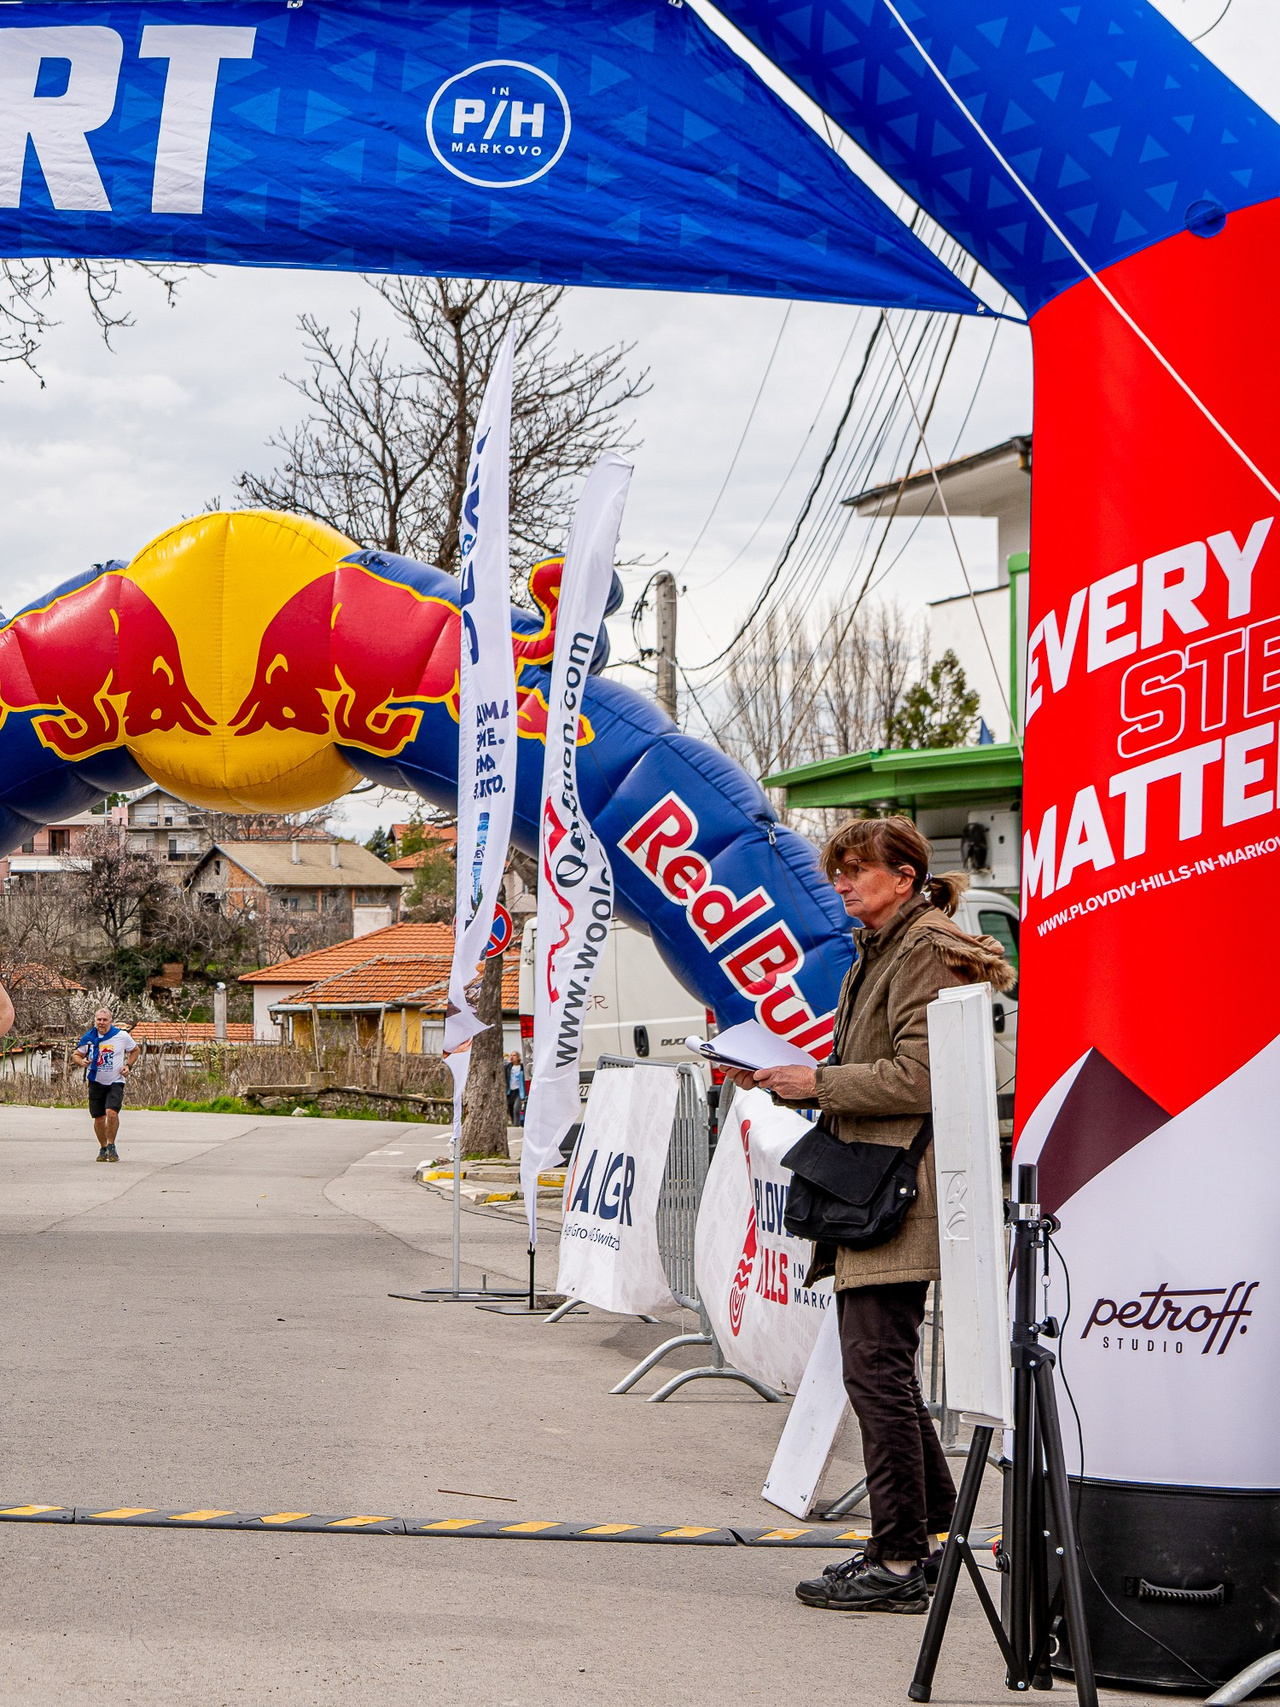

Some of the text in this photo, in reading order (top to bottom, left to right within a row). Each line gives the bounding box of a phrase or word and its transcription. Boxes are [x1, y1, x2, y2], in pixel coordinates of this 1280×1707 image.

[491, 86, 510, 96] IN
[452, 98, 545, 140] P/H
[451, 142, 542, 157] MARKOVO
[1025, 516, 1275, 727] EVERY
[1117, 616, 1280, 759] STE
[1021, 719, 1280, 922] MATTE
[622, 796, 768, 946] Red
[793, 1262, 805, 1280] IN
[1102, 1336, 1184, 1355] STUDIO
